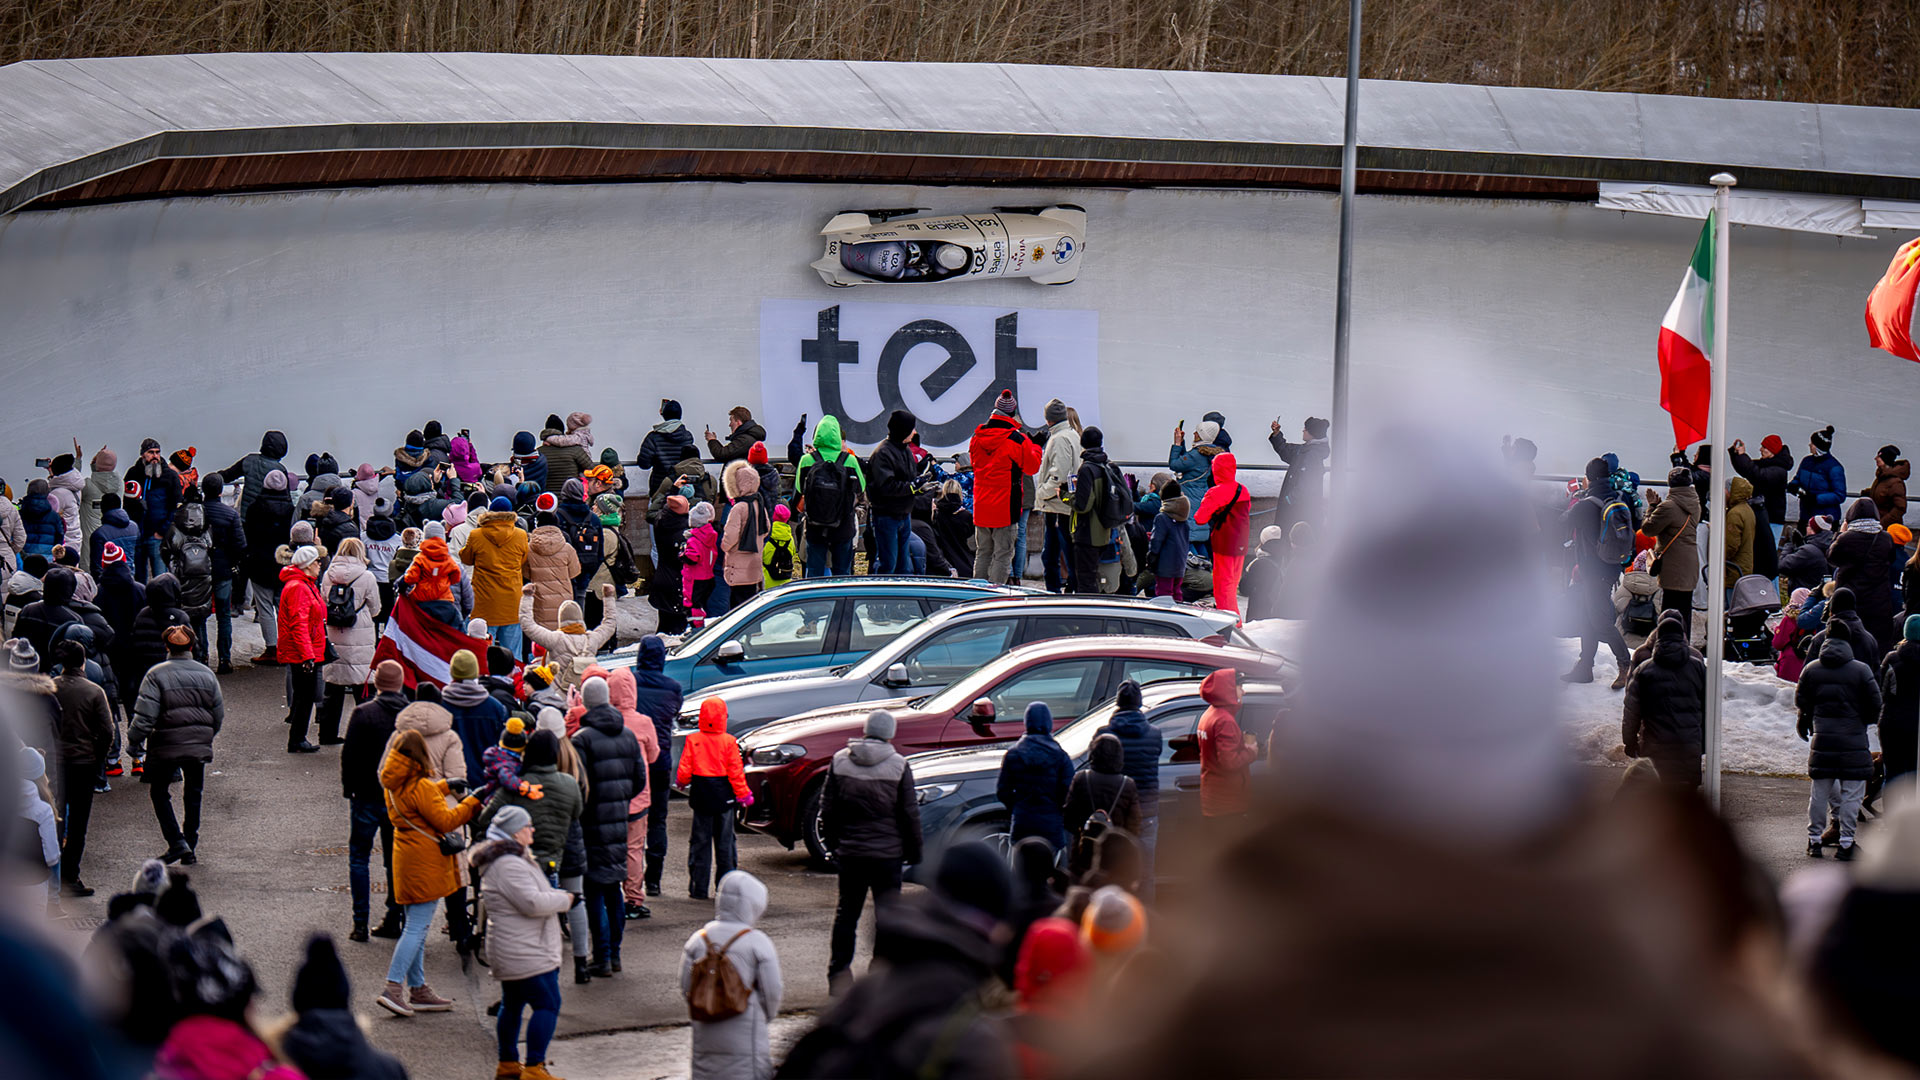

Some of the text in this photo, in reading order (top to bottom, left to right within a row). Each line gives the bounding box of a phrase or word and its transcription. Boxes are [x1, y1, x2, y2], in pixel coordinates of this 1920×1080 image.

[926, 222, 970, 231] Balcia
[974, 218, 999, 229] tet
[829, 241, 838, 255] tet
[971, 245, 986, 275] tet
[988, 241, 1001, 274] Balcia
[1014, 239, 1026, 271] LATVIJA
[891, 252, 900, 270] tet
[801, 304, 1048, 448] tet
